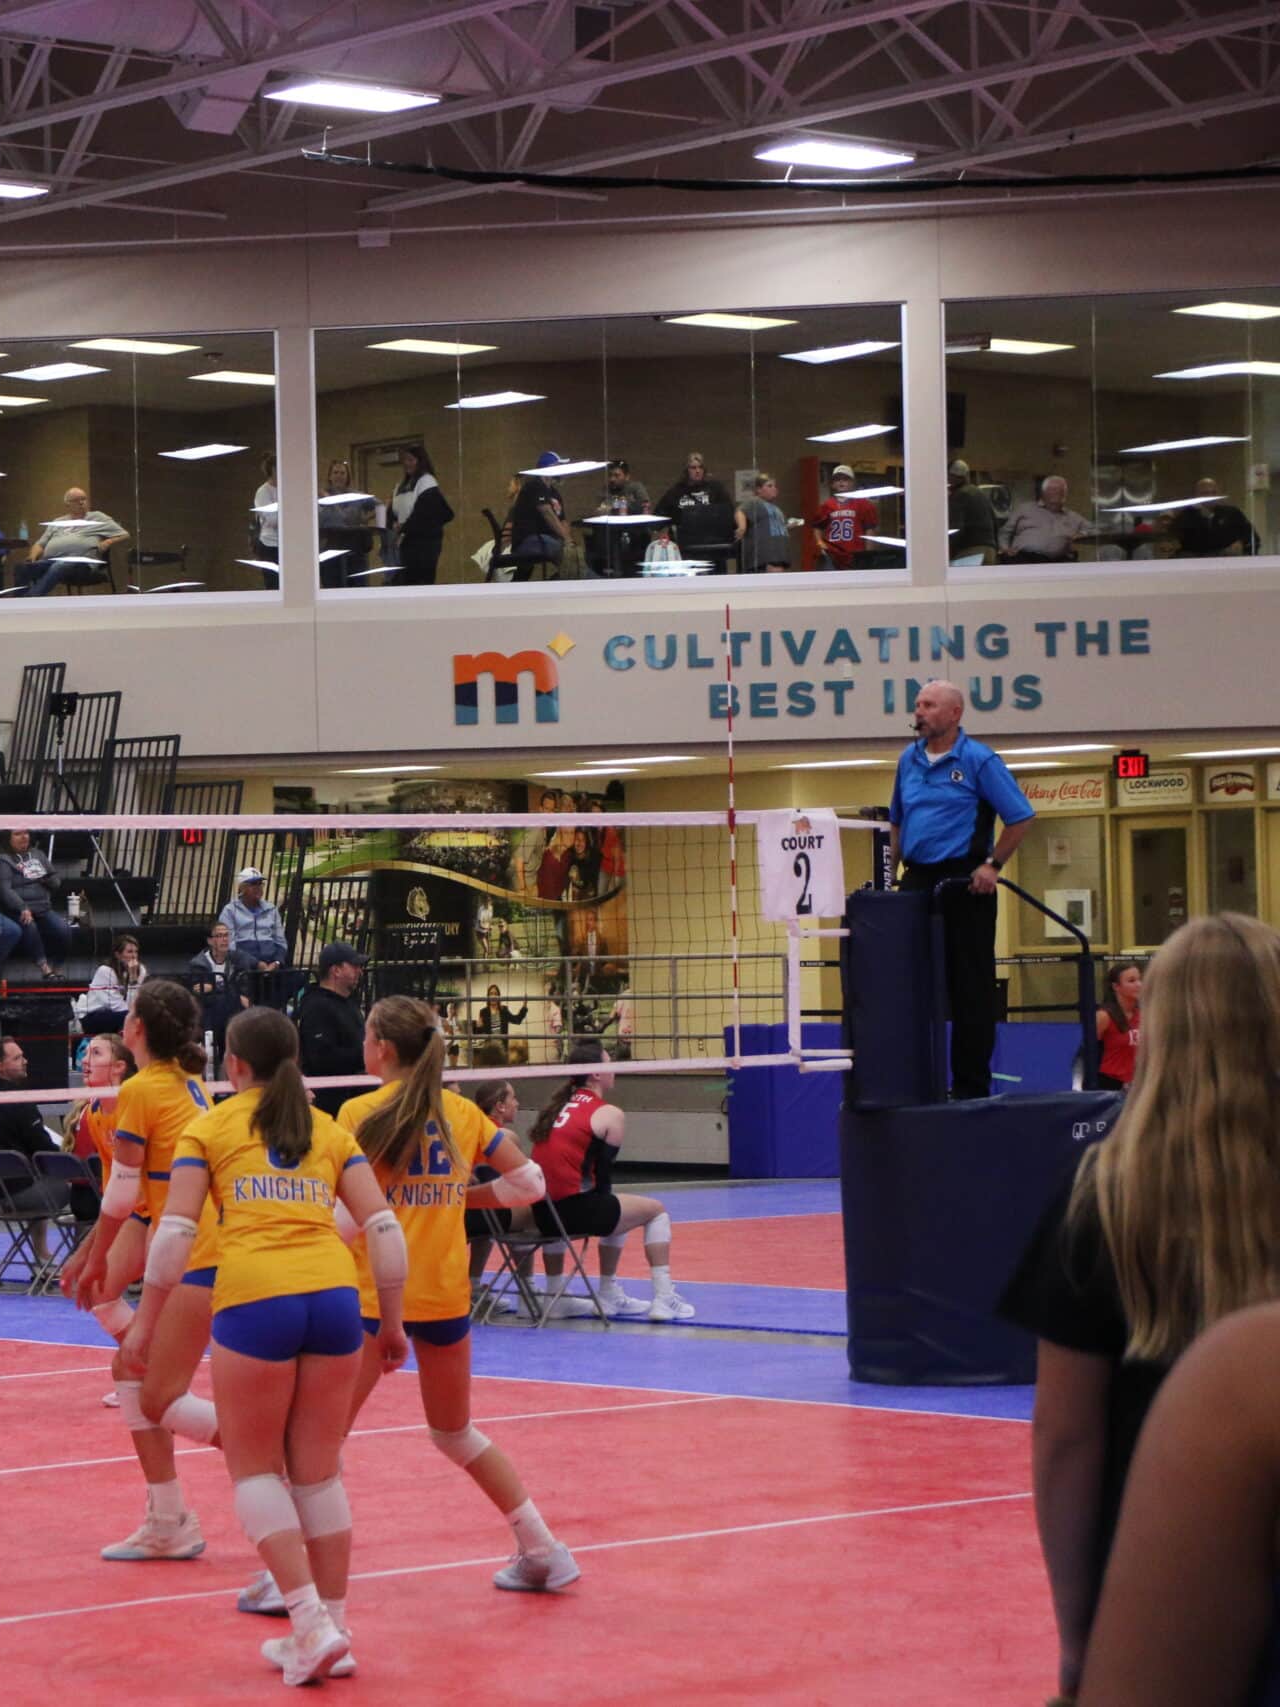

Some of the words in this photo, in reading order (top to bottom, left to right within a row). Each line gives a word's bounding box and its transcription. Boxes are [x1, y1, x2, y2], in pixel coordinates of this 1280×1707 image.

[829, 519, 855, 542] 26
[603, 623, 1010, 671] CULTIVATING
[1034, 619, 1150, 657] THE
[709, 679, 855, 719] BEST
[970, 674, 1042, 714] US
[1118, 756, 1146, 777] EXIT
[1129, 777, 1185, 790] LOCKWOOD
[781, 835, 825, 851] COURT
[793, 852, 813, 915] 2
[553, 1102, 580, 1128] 5
[234, 1175, 334, 1208] KNIGHTS
[385, 1182, 466, 1207] KNIGHTS
